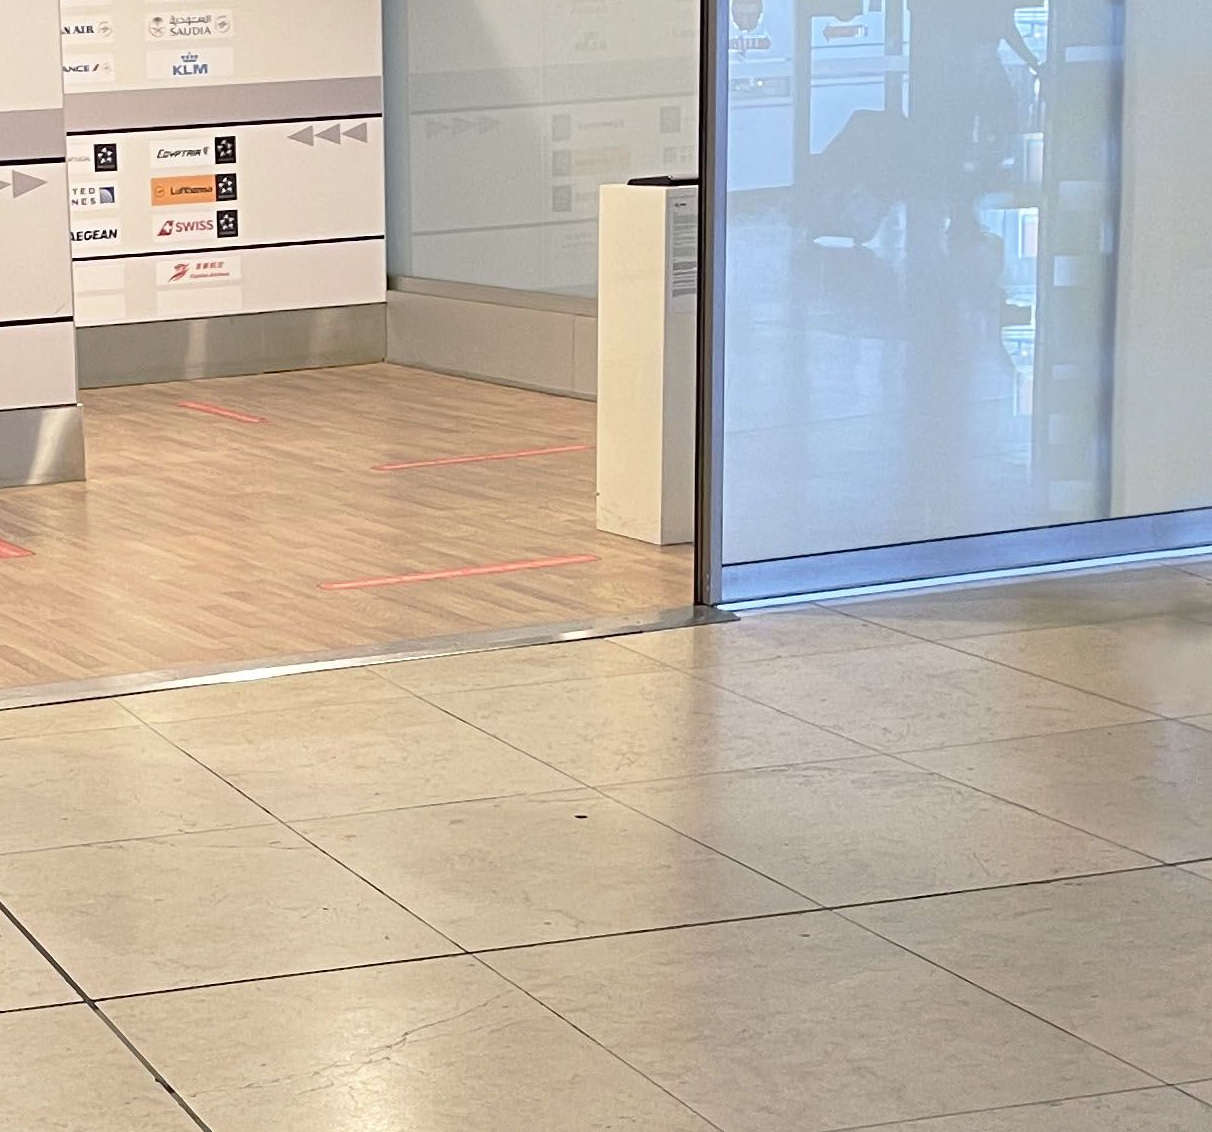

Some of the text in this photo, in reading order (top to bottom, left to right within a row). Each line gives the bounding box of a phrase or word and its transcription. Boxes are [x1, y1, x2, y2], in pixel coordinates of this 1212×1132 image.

[170, 27, 212, 37] SAUDIA
[172, 63, 208, 76] KLM
[175, 220, 214, 233] SWISS
